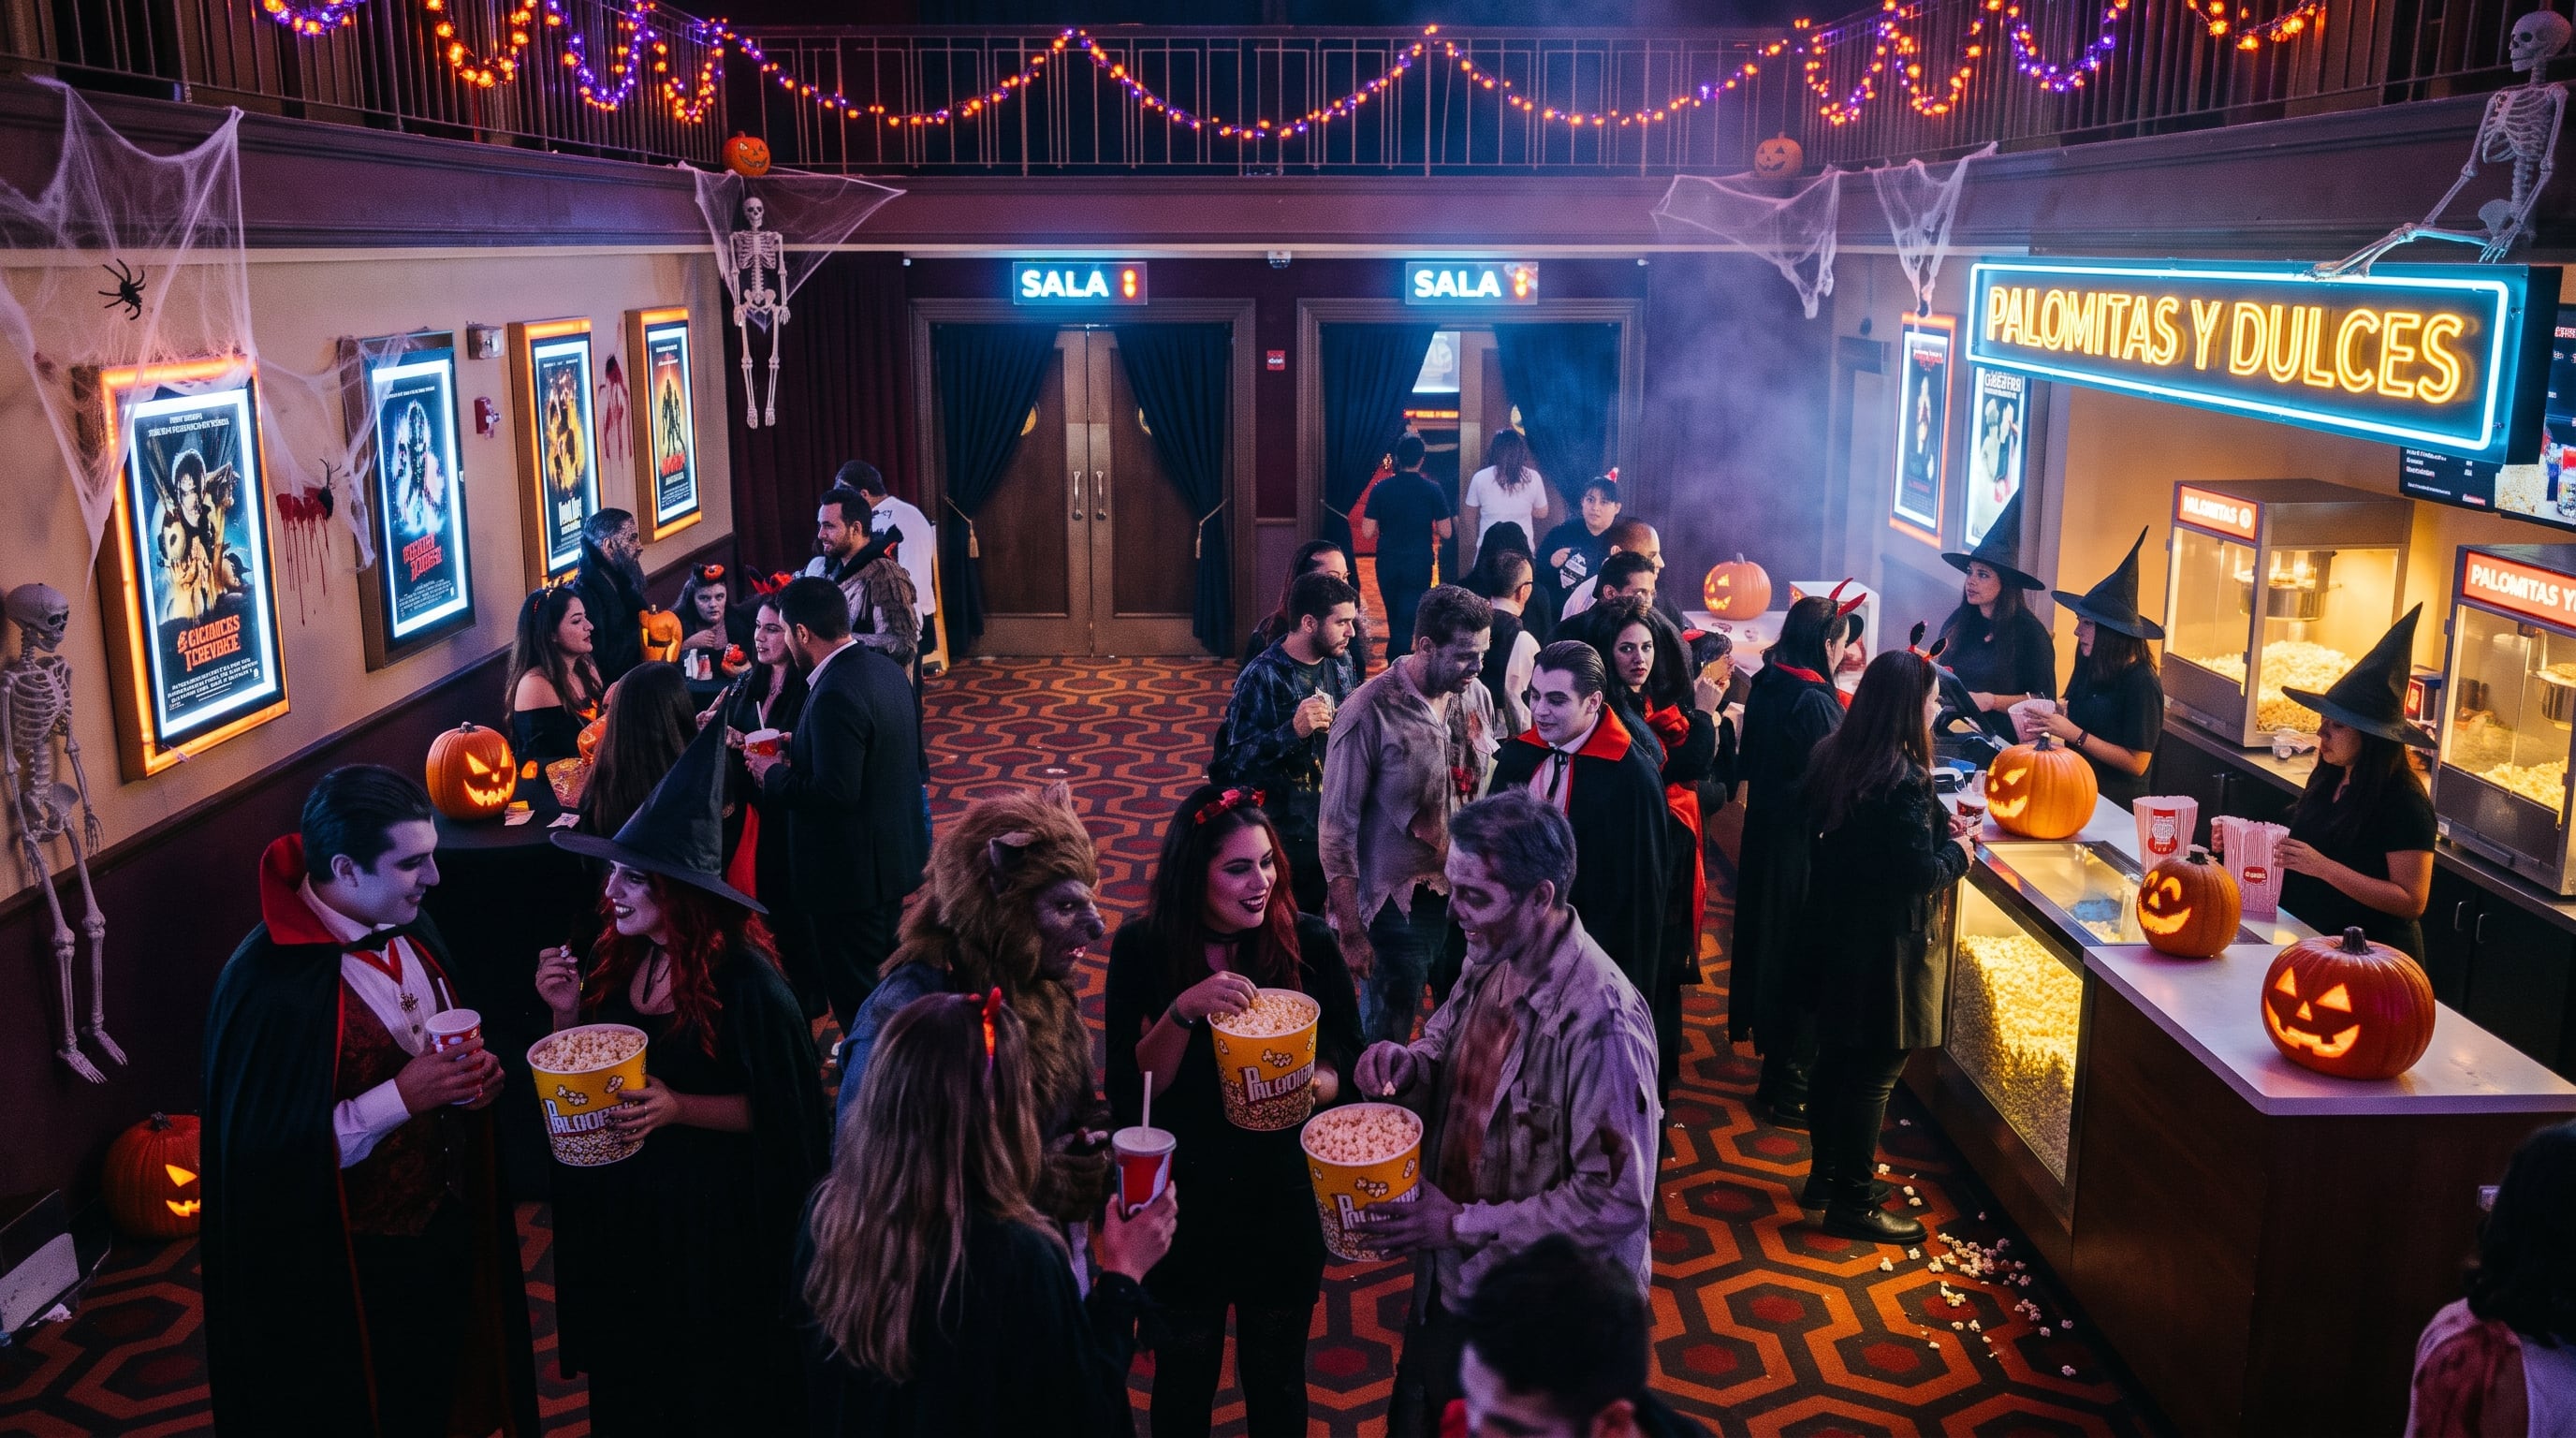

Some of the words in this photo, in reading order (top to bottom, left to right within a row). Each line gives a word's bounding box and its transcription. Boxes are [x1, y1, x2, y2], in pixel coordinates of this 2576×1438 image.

[1021, 270, 1109, 298] SALA
[1414, 270, 1501, 298] SALA
[1986, 286, 2180, 366] PALOMITAS
[2190, 299, 2222, 370] Y
[2229, 301, 2465, 404] DULCES
[2470, 564, 2559, 607] PALOMITAS
[2563, 588, 2576, 613] Y
